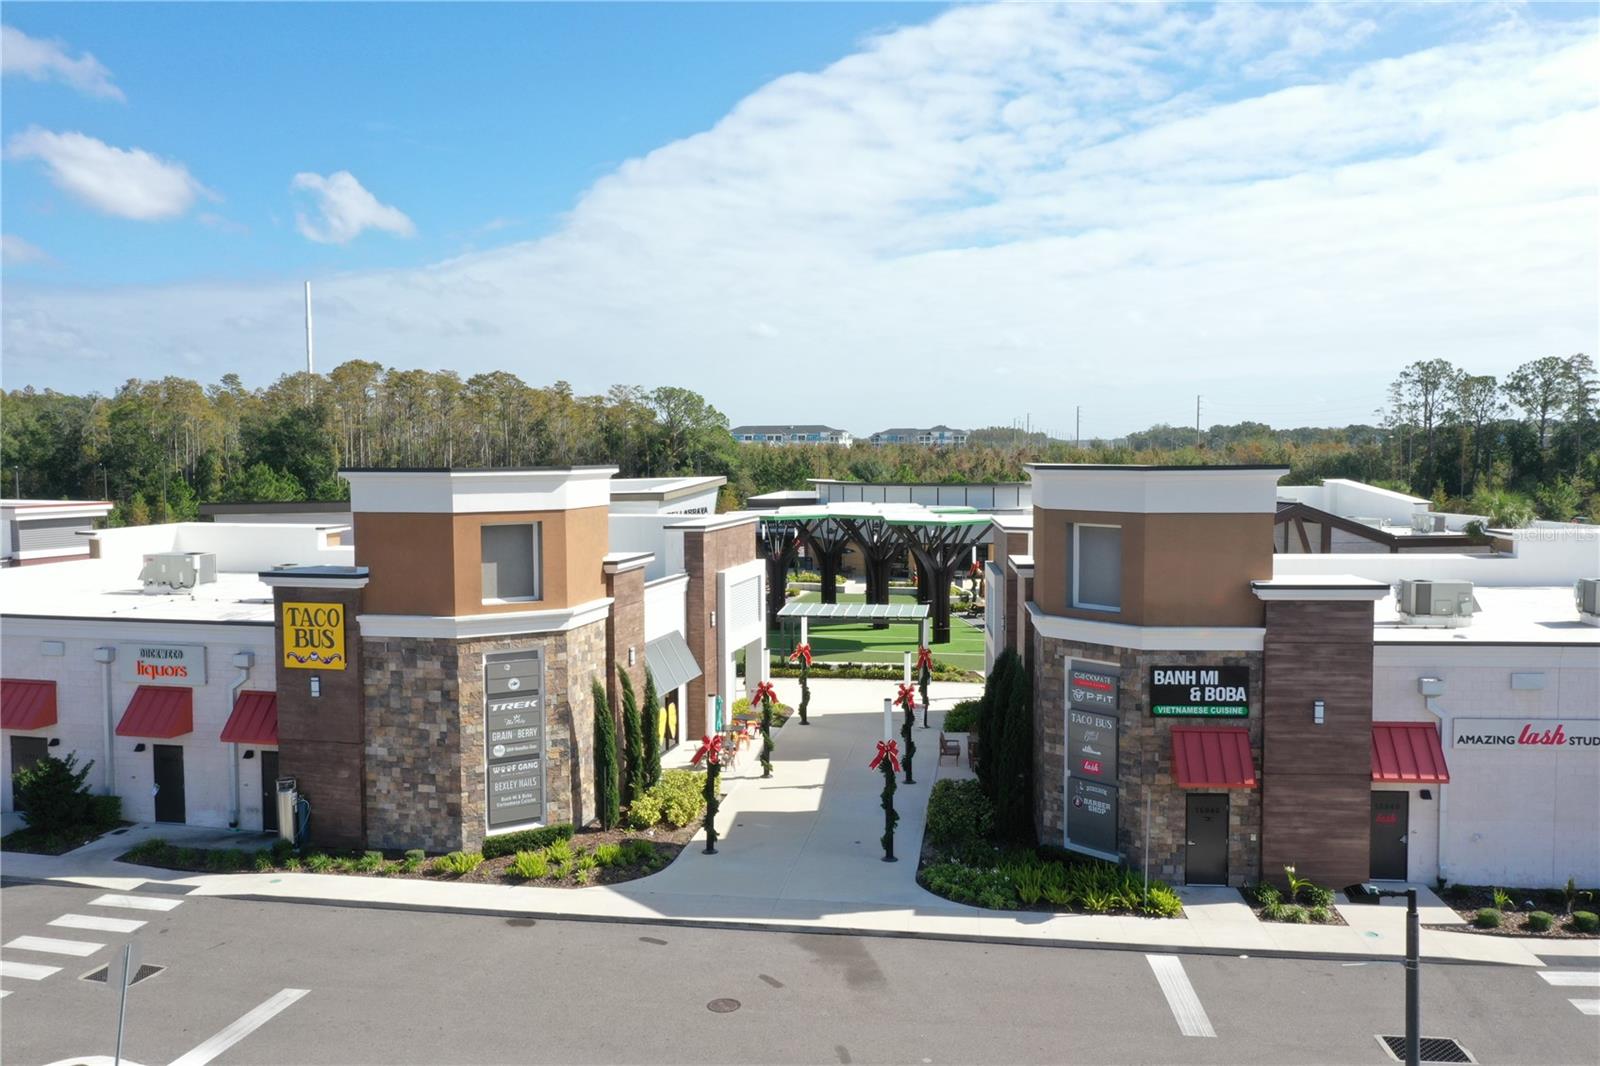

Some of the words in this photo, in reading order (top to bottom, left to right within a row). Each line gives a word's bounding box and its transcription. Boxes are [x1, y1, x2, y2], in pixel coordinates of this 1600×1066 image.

[286, 607, 341, 628] TACO
[293, 628, 335, 649] BUS
[136, 659, 188, 680] liquors
[1074, 672, 1111, 684] CHECKMATE
[1153, 670, 1197, 686] BANH
[1199, 670, 1219, 686] MI
[1189, 686, 1201, 702] &
[1204, 686, 1247, 702] BOBA
[490, 700, 538, 711] TREK
[1157, 706, 1209, 714] VIETNAMESE
[1210, 706, 1243, 714] CUISINE
[1071, 713, 1093, 726] TACO
[1095, 717, 1113, 730] BUS
[492, 730, 513, 741] GRAIN
[517, 728, 537, 738] BERRY
[1456, 735, 1516, 745] AMAZING
[1517, 723, 1568, 746] lash
[1569, 736, 1600, 746] STUD
[518, 762, 538, 771] GANG
[495, 779, 517, 791] BEXLEY
[519, 777, 537, 788] NAILS
[1083, 797, 1111, 811] BARBER
[1087, 805, 1107, 815] SHOP
